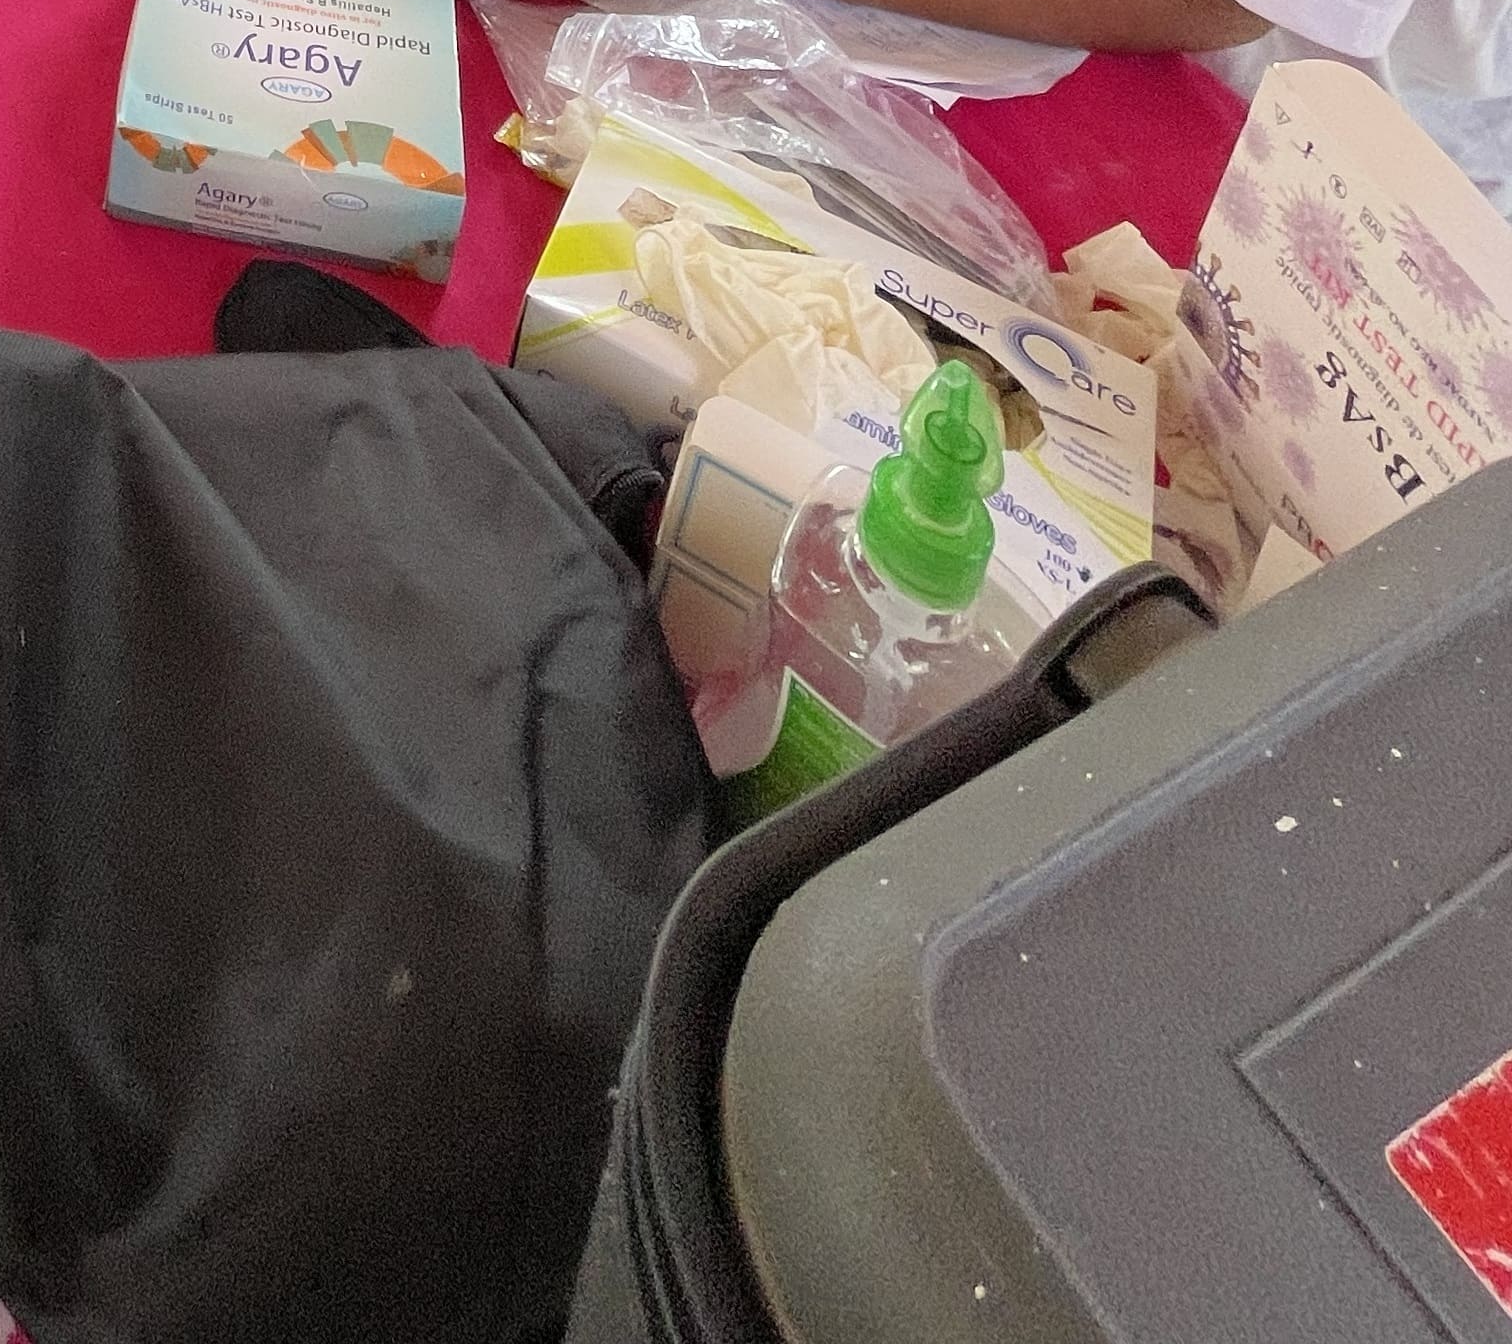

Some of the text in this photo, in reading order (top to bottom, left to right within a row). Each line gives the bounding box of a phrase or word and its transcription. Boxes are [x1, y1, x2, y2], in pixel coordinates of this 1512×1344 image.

[229, 6, 265, 29] Test
[271, 15, 370, 46] Diagnostic
[376, 35, 431, 55] Rapid
[145, 93, 233, 125] 50 Test Strips
[267, 80, 325, 99] AGARY
[617, 289, 682, 335] Latex
[880, 269, 1137, 416] Super Care
[1353, 314, 1419, 398] TEST
[1322, 314, 1400, 412] diagnostic
[1315, 351, 1427, 506] BsAg
[1402, 414, 1423, 441] de
[1427, 400, 1489, 467] PID
